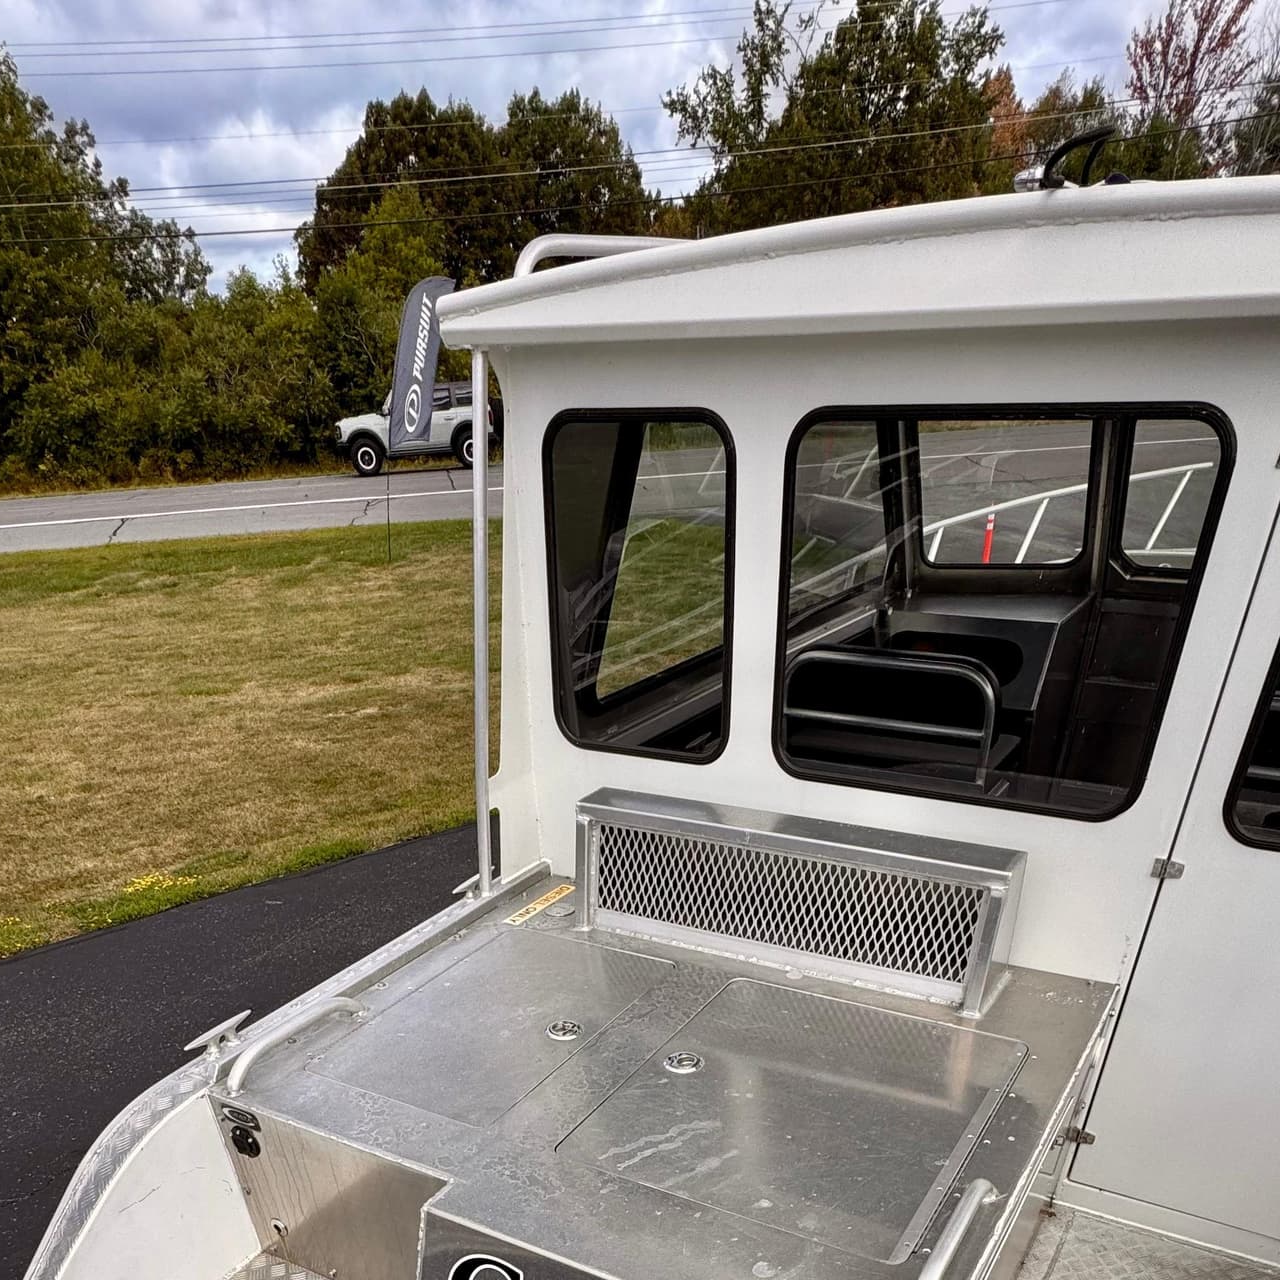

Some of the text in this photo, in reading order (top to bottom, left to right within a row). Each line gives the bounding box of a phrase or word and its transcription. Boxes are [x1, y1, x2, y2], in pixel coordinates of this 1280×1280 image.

[413, 292, 432, 381] PURSUIT
[509, 886, 570, 923] DIESEL ONLY
